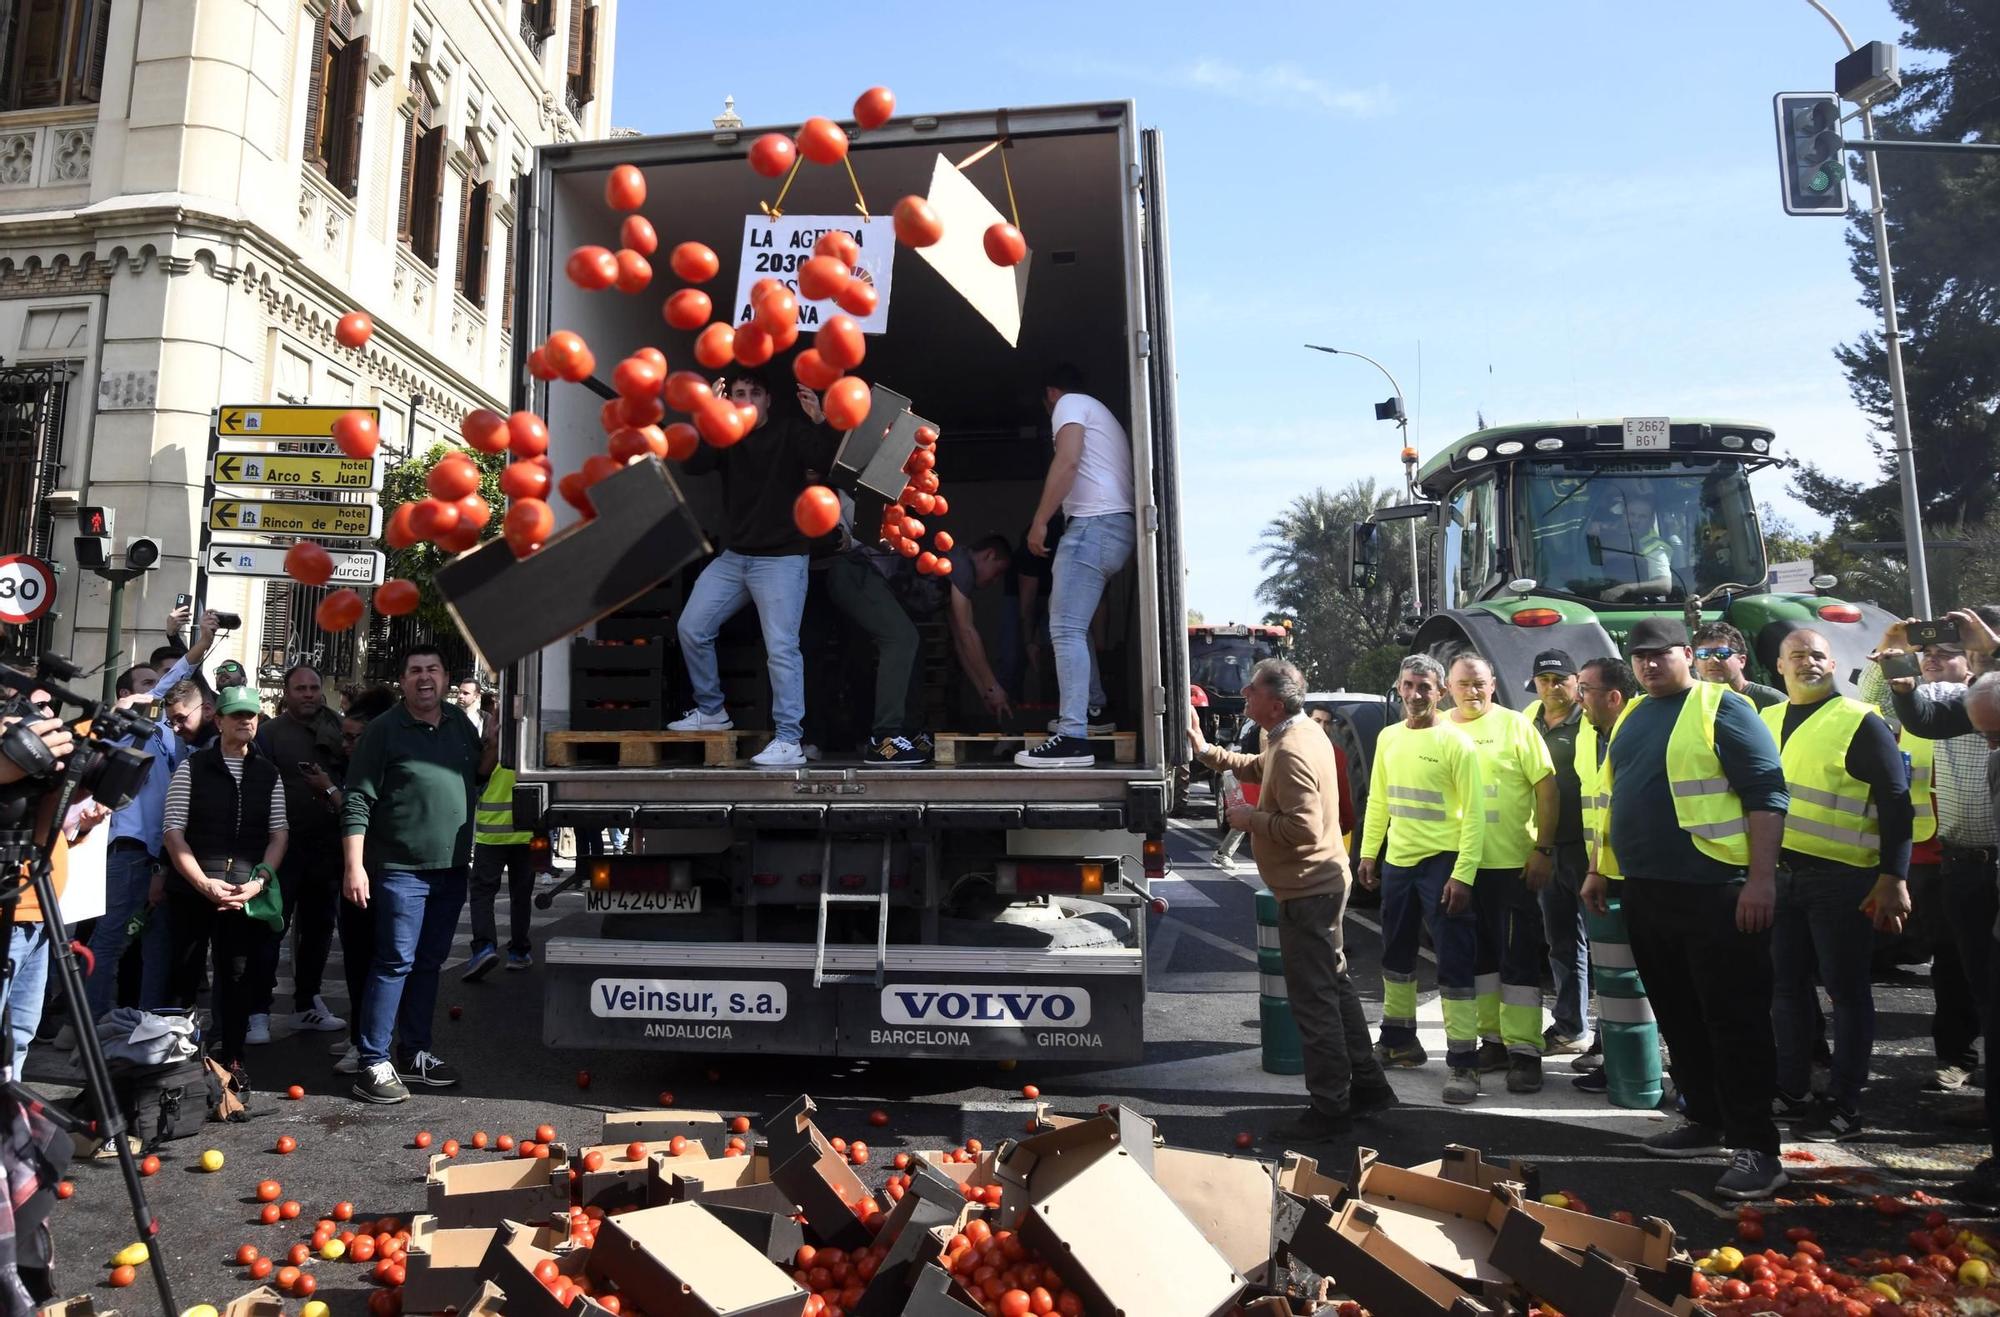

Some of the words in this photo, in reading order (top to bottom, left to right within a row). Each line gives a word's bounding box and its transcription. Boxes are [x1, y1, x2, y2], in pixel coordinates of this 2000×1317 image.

[750, 229, 773, 247] LA
[1627, 421, 1633, 432] E
[1638, 421, 1665, 432] 2662
[1636, 435, 1657, 446] BGY
[341, 461, 368, 470] hotel
[267, 469, 300, 482] Arco
[311, 470, 324, 483] S.
[335, 472, 366, 485] Juan
[338, 508, 366, 518] hotel
[311, 519, 326, 529] de
[335, 520, 365, 532] Pepe
[347, 556, 371, 564] hotel
[0, 577, 39, 600] 30
[22, 738, 42, 759] SONY
[601, 984, 718, 1018] Veinsur,
[729, 992, 781, 1014] s.a.
[895, 992, 1075, 1021] VOLVO
[644, 1023, 733, 1039] ANDALUCIA
[870, 1029, 970, 1046] BARCELONA
[1036, 1032, 1103, 1047] GIRONA
